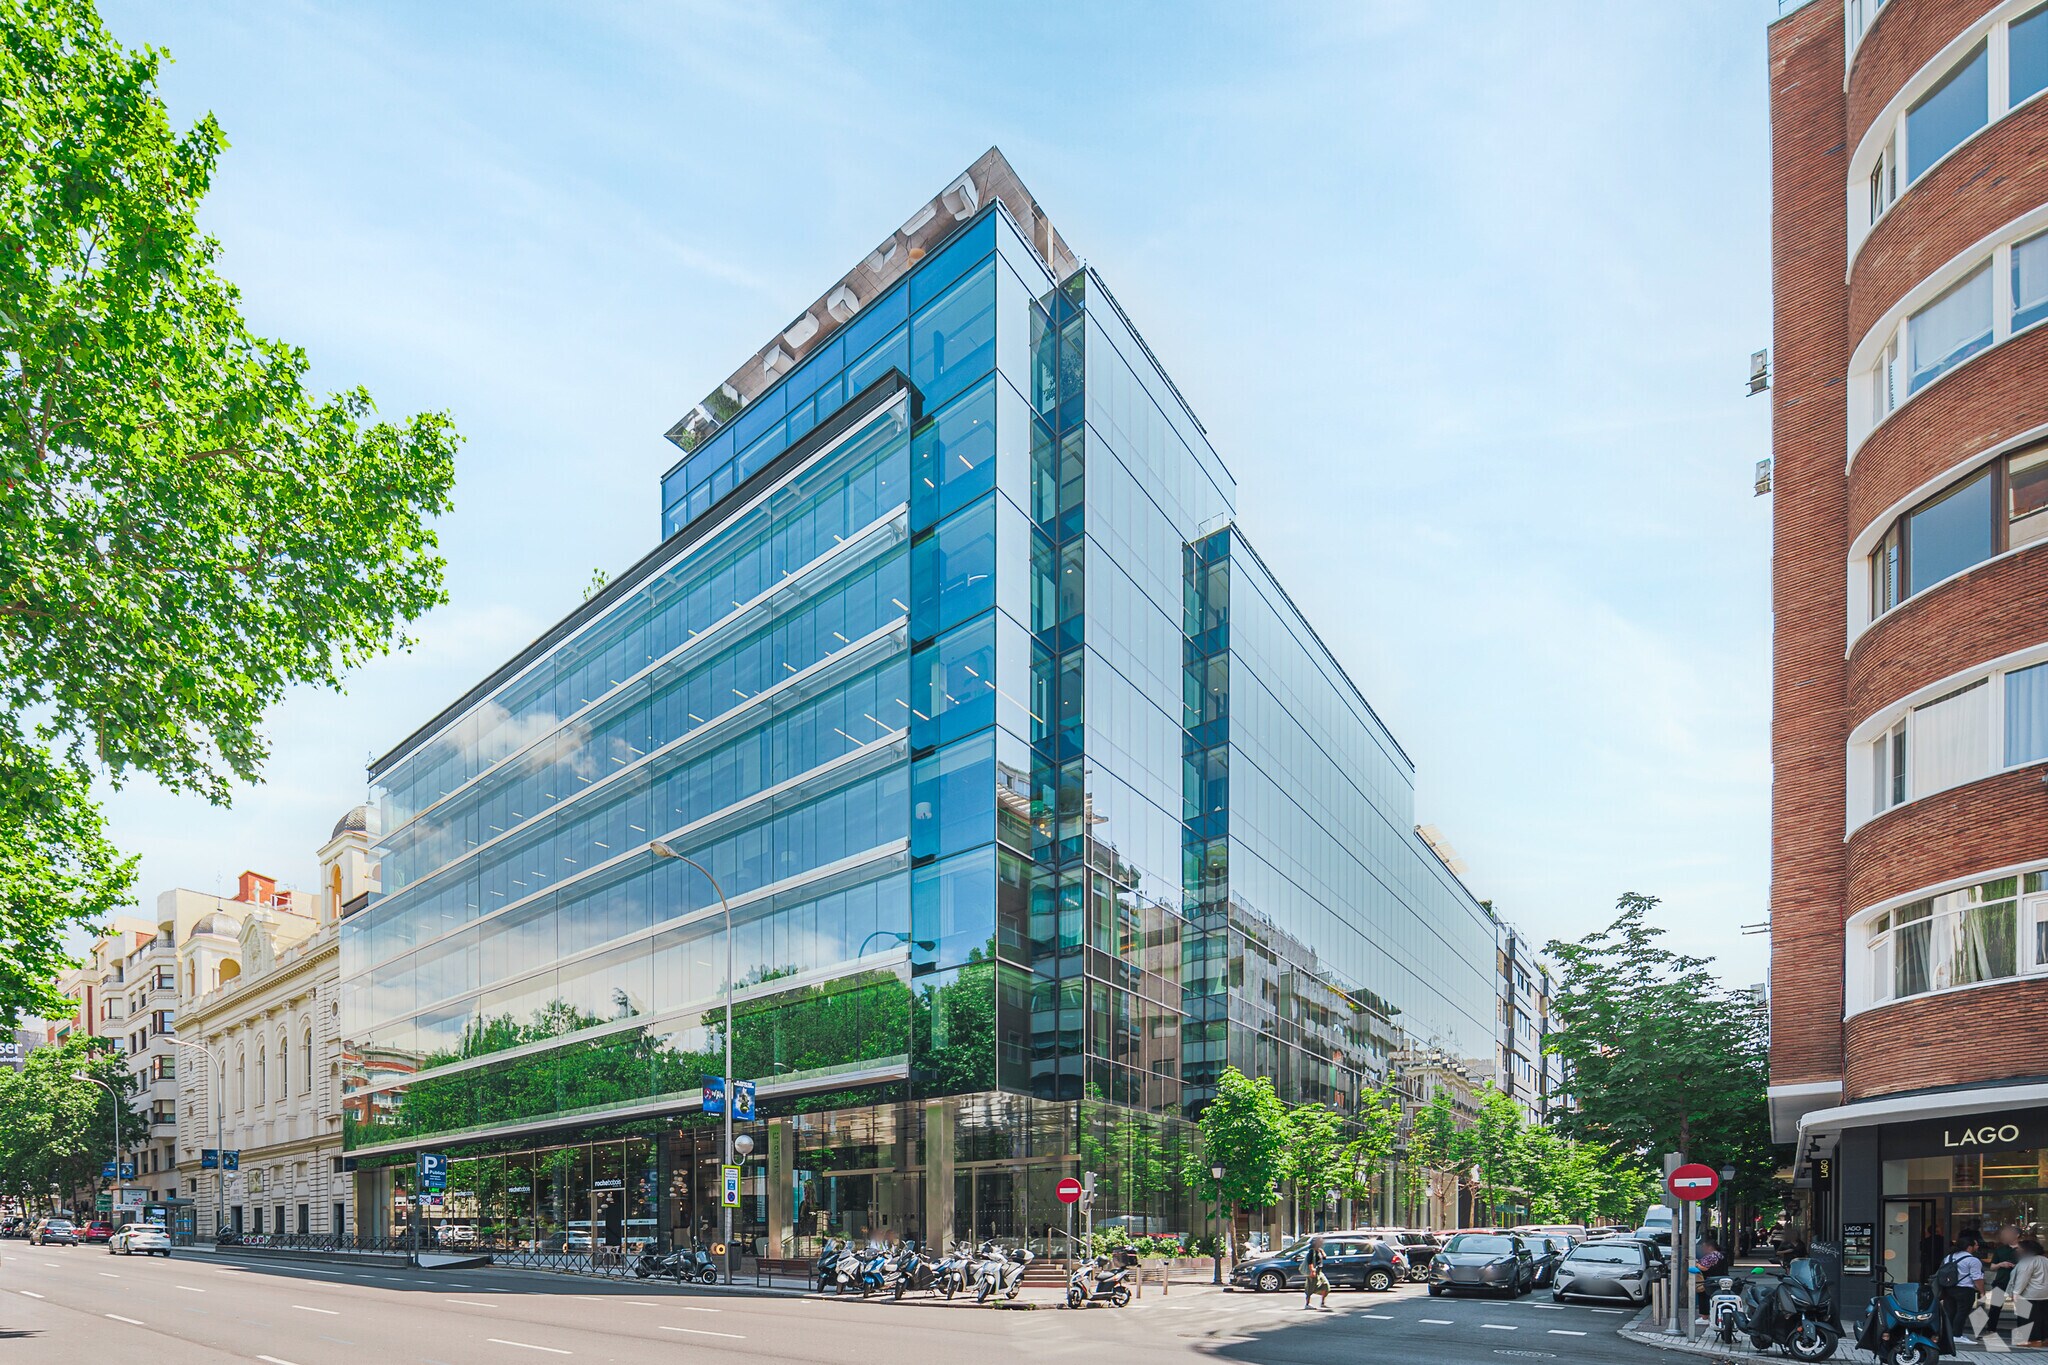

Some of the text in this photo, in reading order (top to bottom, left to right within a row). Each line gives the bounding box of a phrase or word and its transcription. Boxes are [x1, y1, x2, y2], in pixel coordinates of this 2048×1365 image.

[1944, 1124, 2019, 1147] LAGO
[424, 1156, 438, 1174] P
[1820, 1159, 1829, 1178] LAGO
